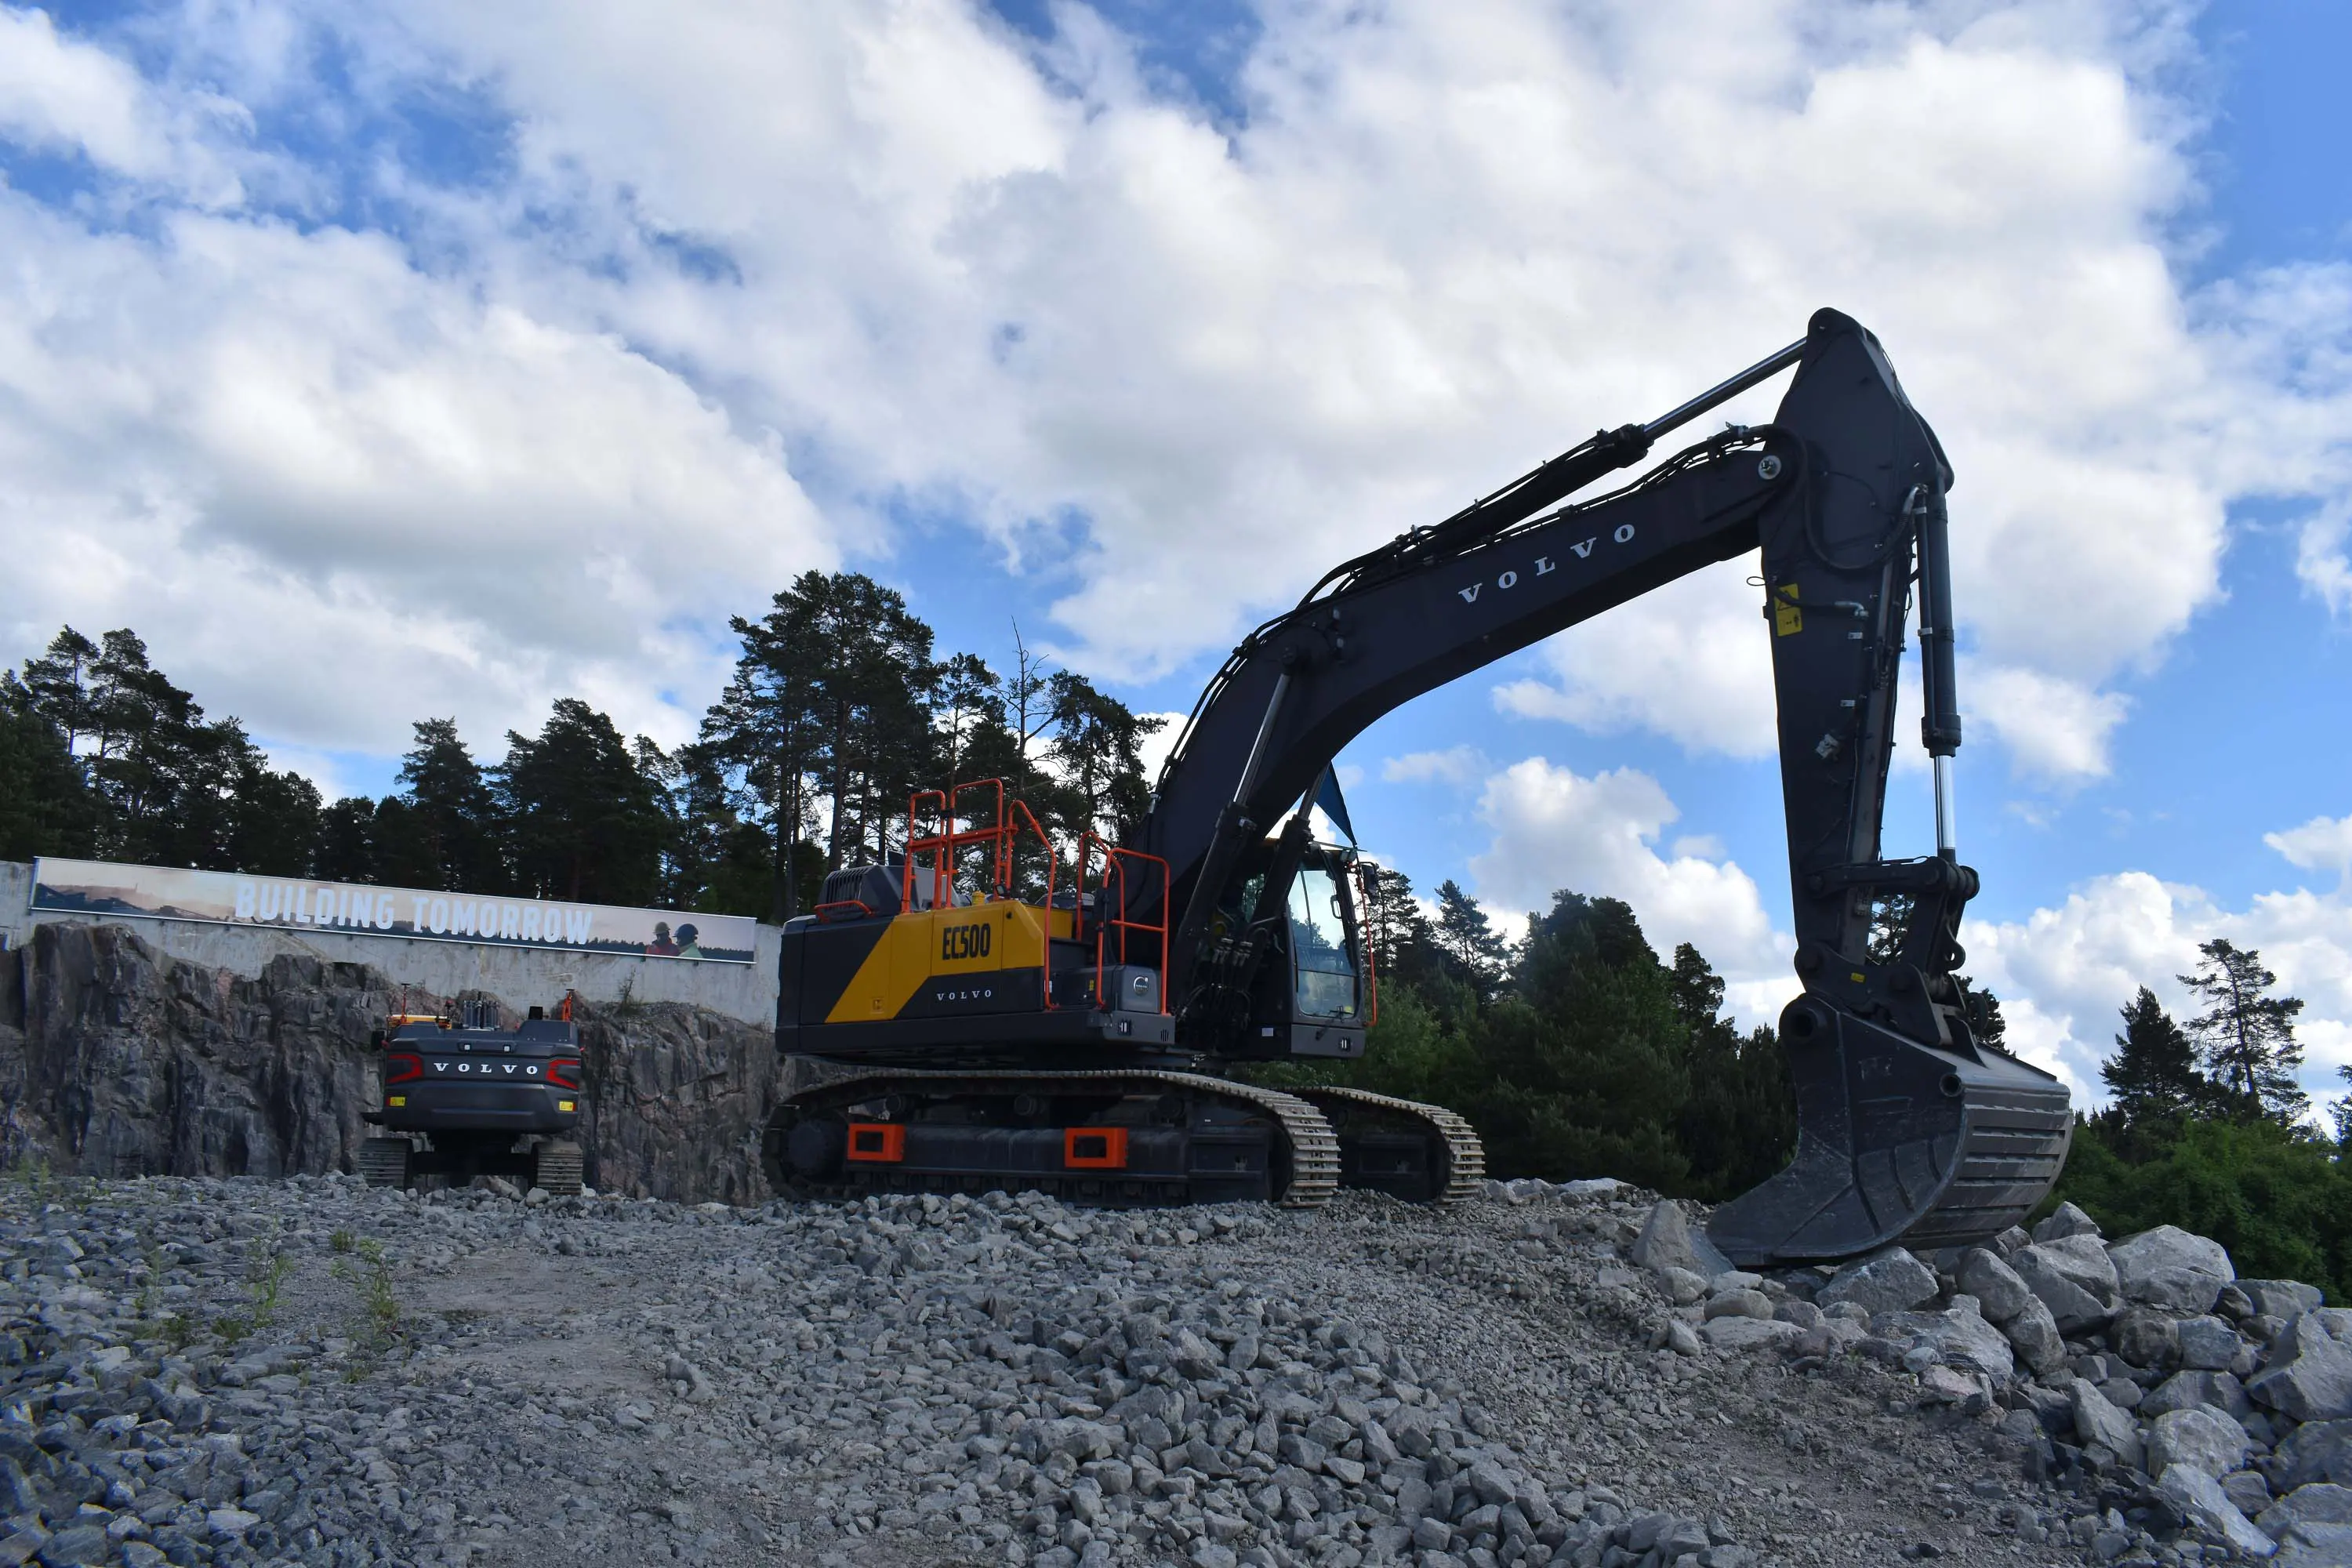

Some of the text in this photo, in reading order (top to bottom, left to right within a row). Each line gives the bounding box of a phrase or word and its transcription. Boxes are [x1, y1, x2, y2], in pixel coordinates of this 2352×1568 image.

[1458, 524, 1635, 602] VOLVO
[235, 881, 592, 945] BUILDING TOMORROW
[942, 923, 990, 960] EC500
[936, 989, 992, 1000] VOLVO
[434, 1062, 538, 1074] VOLVO
